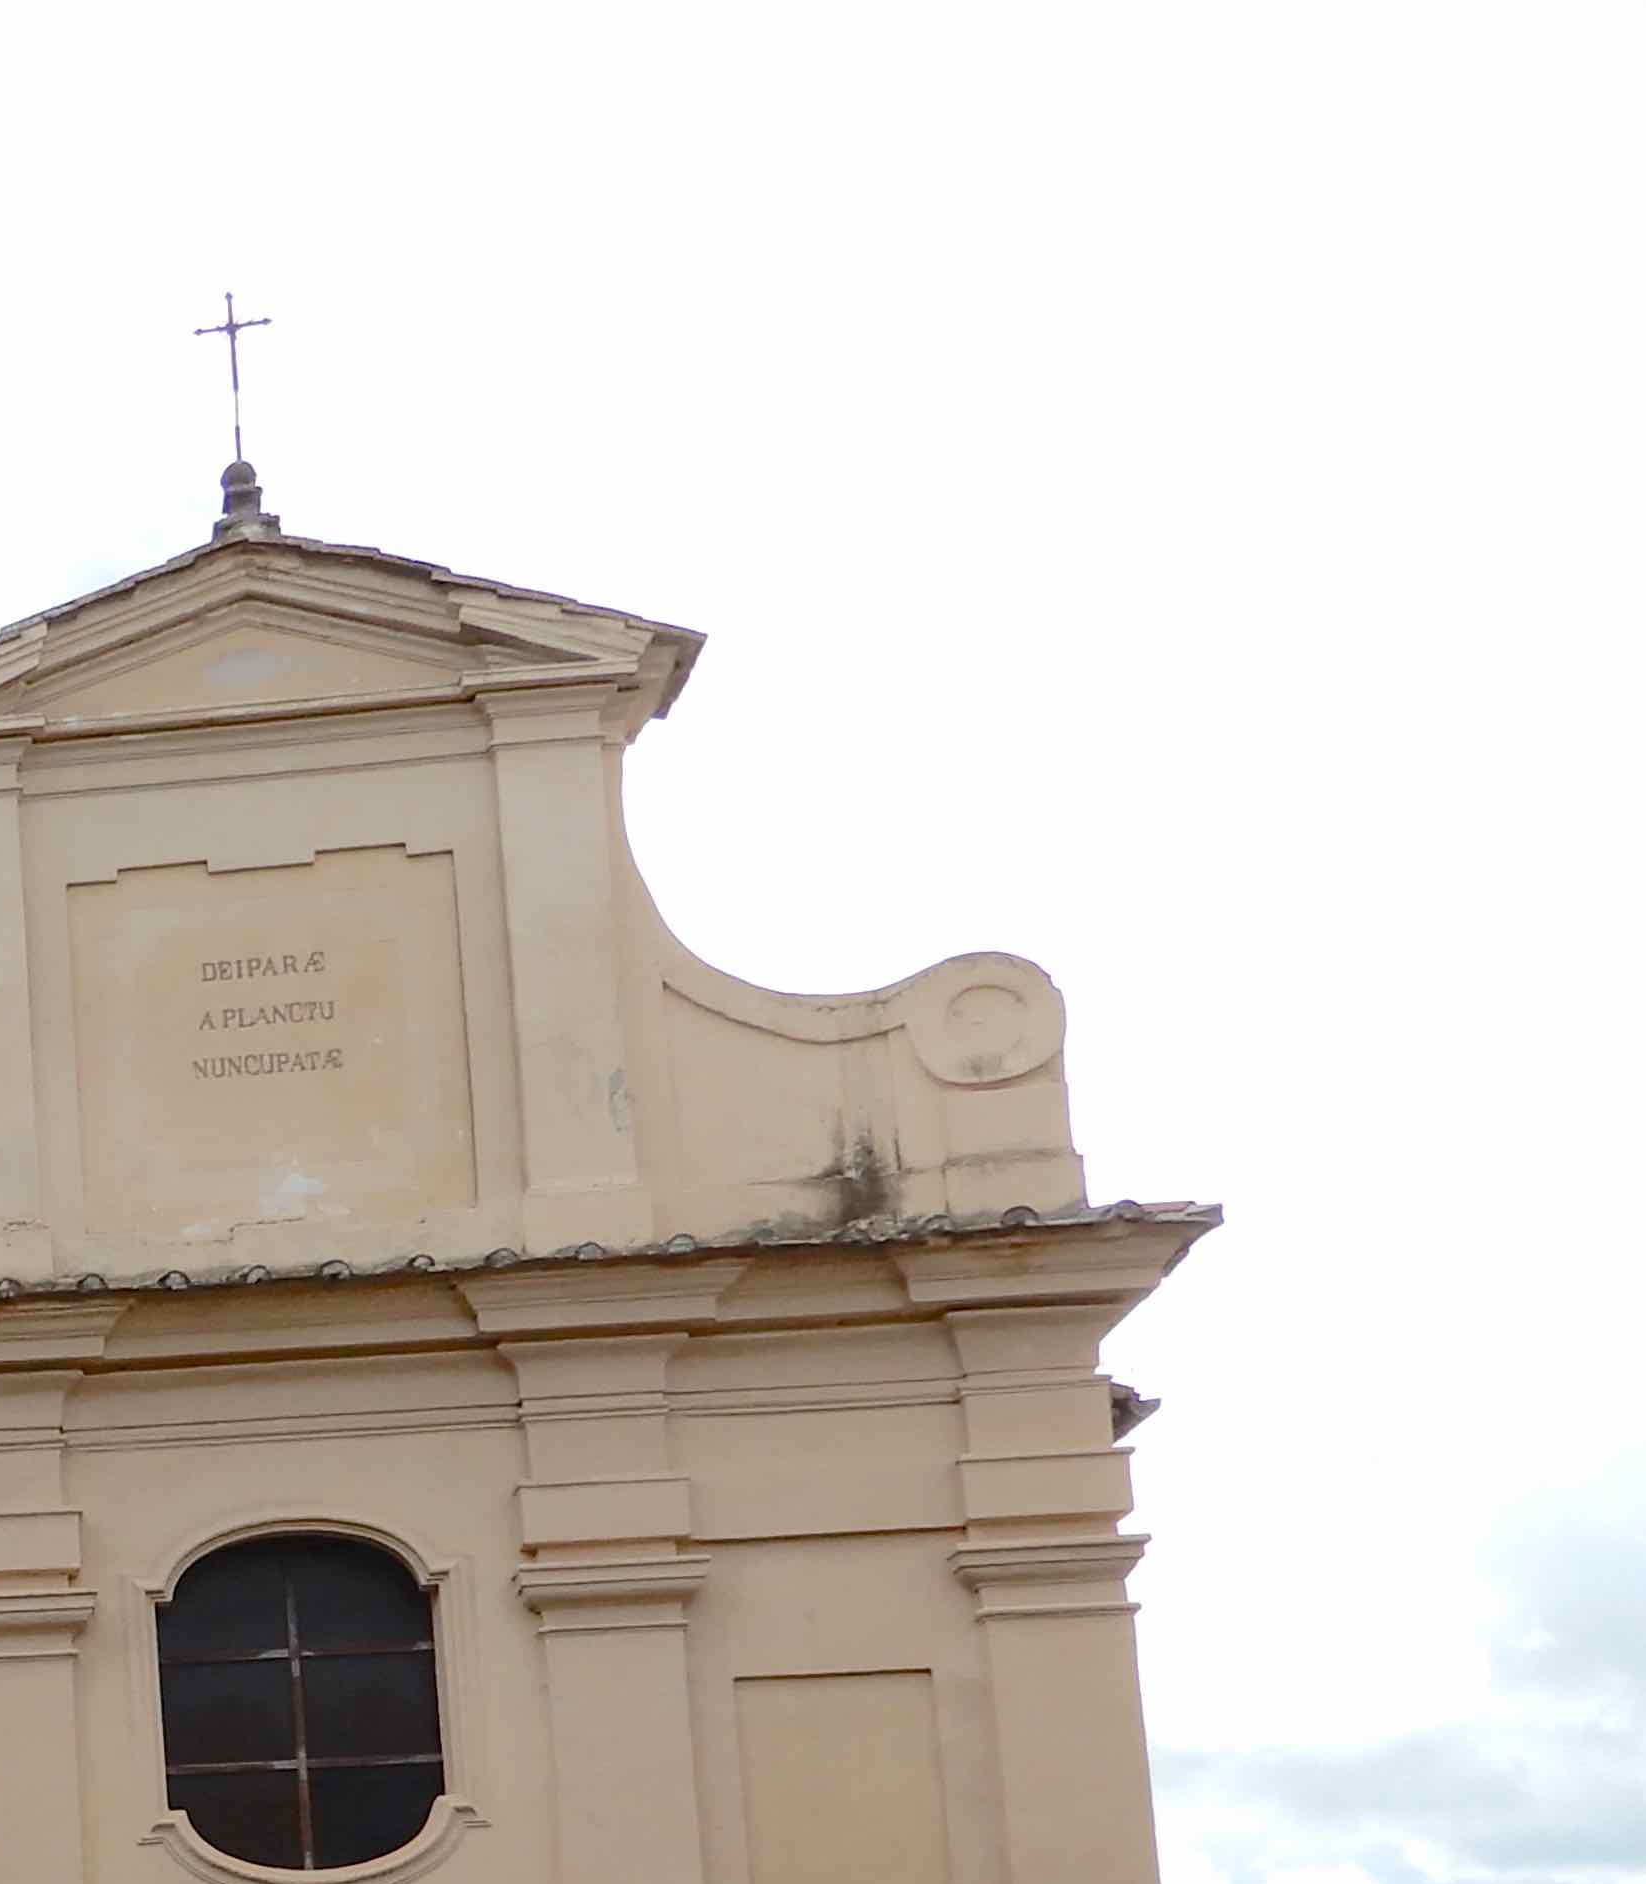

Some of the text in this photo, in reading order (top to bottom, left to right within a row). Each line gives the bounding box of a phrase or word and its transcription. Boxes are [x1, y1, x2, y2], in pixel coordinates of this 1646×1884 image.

[201, 951, 325, 982] DEIPARÆ
[198, 1000, 335, 1031] A PLANCTU
[192, 1048, 343, 1080] NUNCUPATÆ
